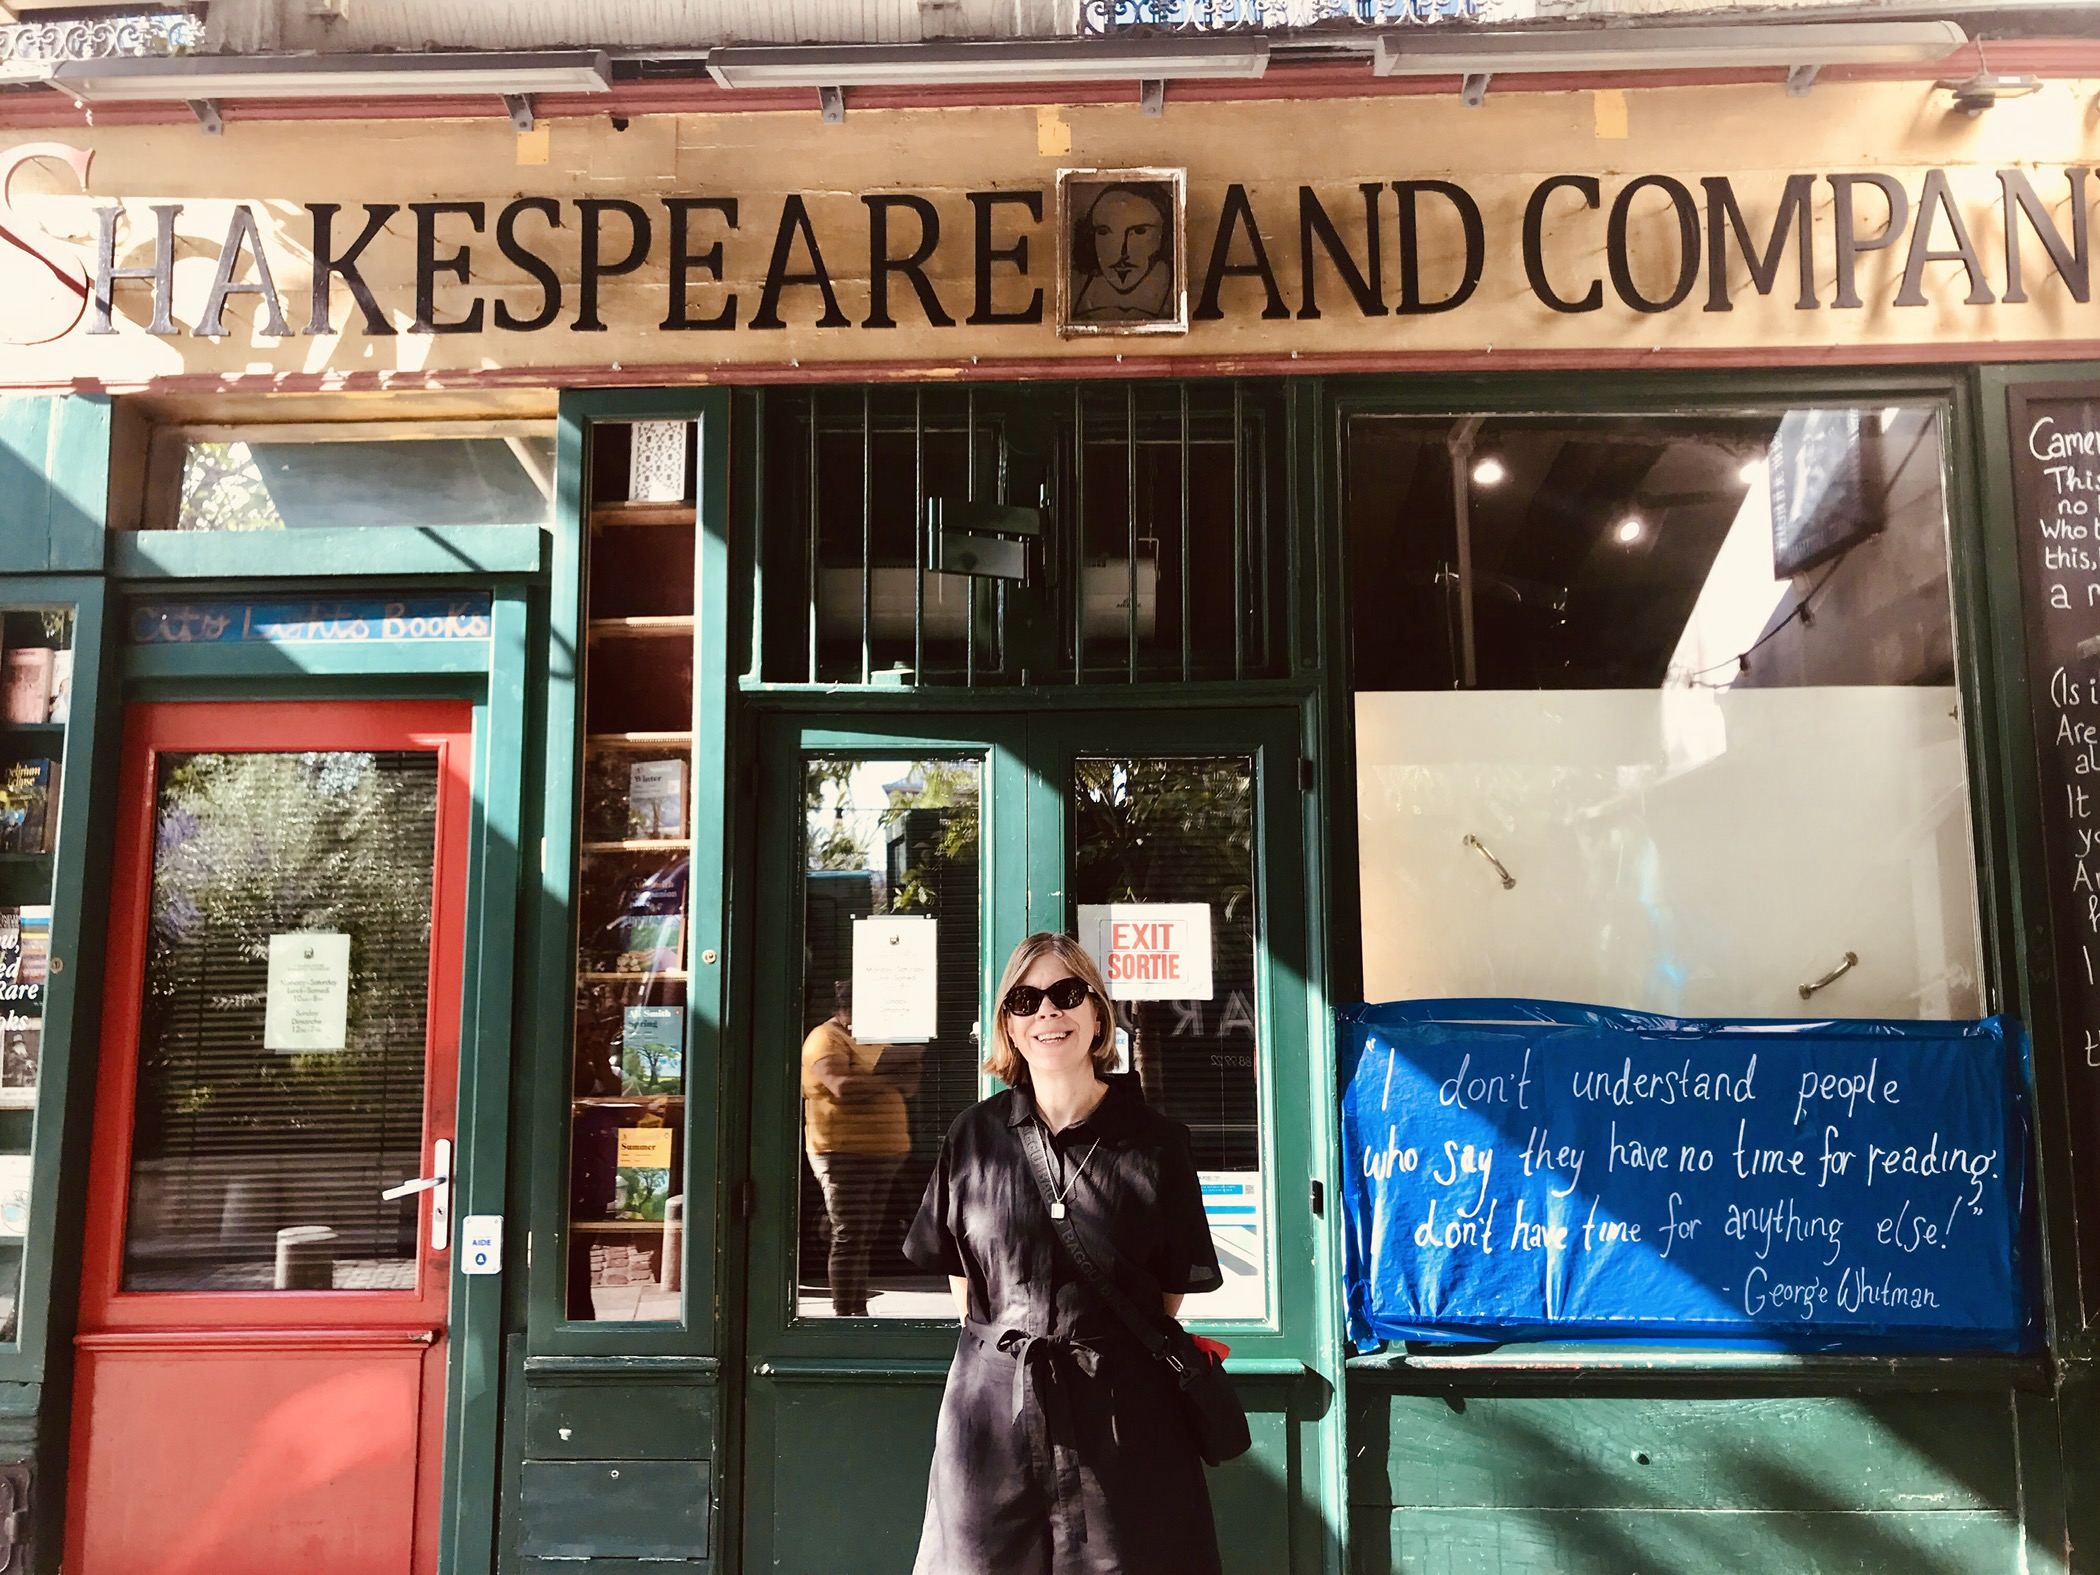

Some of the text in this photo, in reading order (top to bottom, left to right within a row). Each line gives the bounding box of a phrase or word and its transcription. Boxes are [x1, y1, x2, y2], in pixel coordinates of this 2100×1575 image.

[0, 141, 1043, 345] SHAKESPEARE
[1193, 167, 2100, 321] AND COMPAN
[2058, 499, 2088, 515] no
[2051, 583, 2072, 609] a
[2056, 713, 2098, 746] Are
[1112, 924, 1174, 950] EXIT
[1107, 954, 1180, 980] SORTIE
[1440, 1048, 1531, 1110] don't
[1572, 1054, 1756, 1106] understand
[1794, 1057, 1901, 1125] people
[1363, 1118, 1998, 1218] who say they have no time for reading.
[1511, 1198, 1569, 1252] have
[1582, 1194, 1642, 1251] time
[1658, 1192, 1702, 1258] for
[1724, 1198, 1844, 1266] anything
[1745, 1266, 1829, 1320] George
[1836, 1266, 1941, 1314] Whitman
